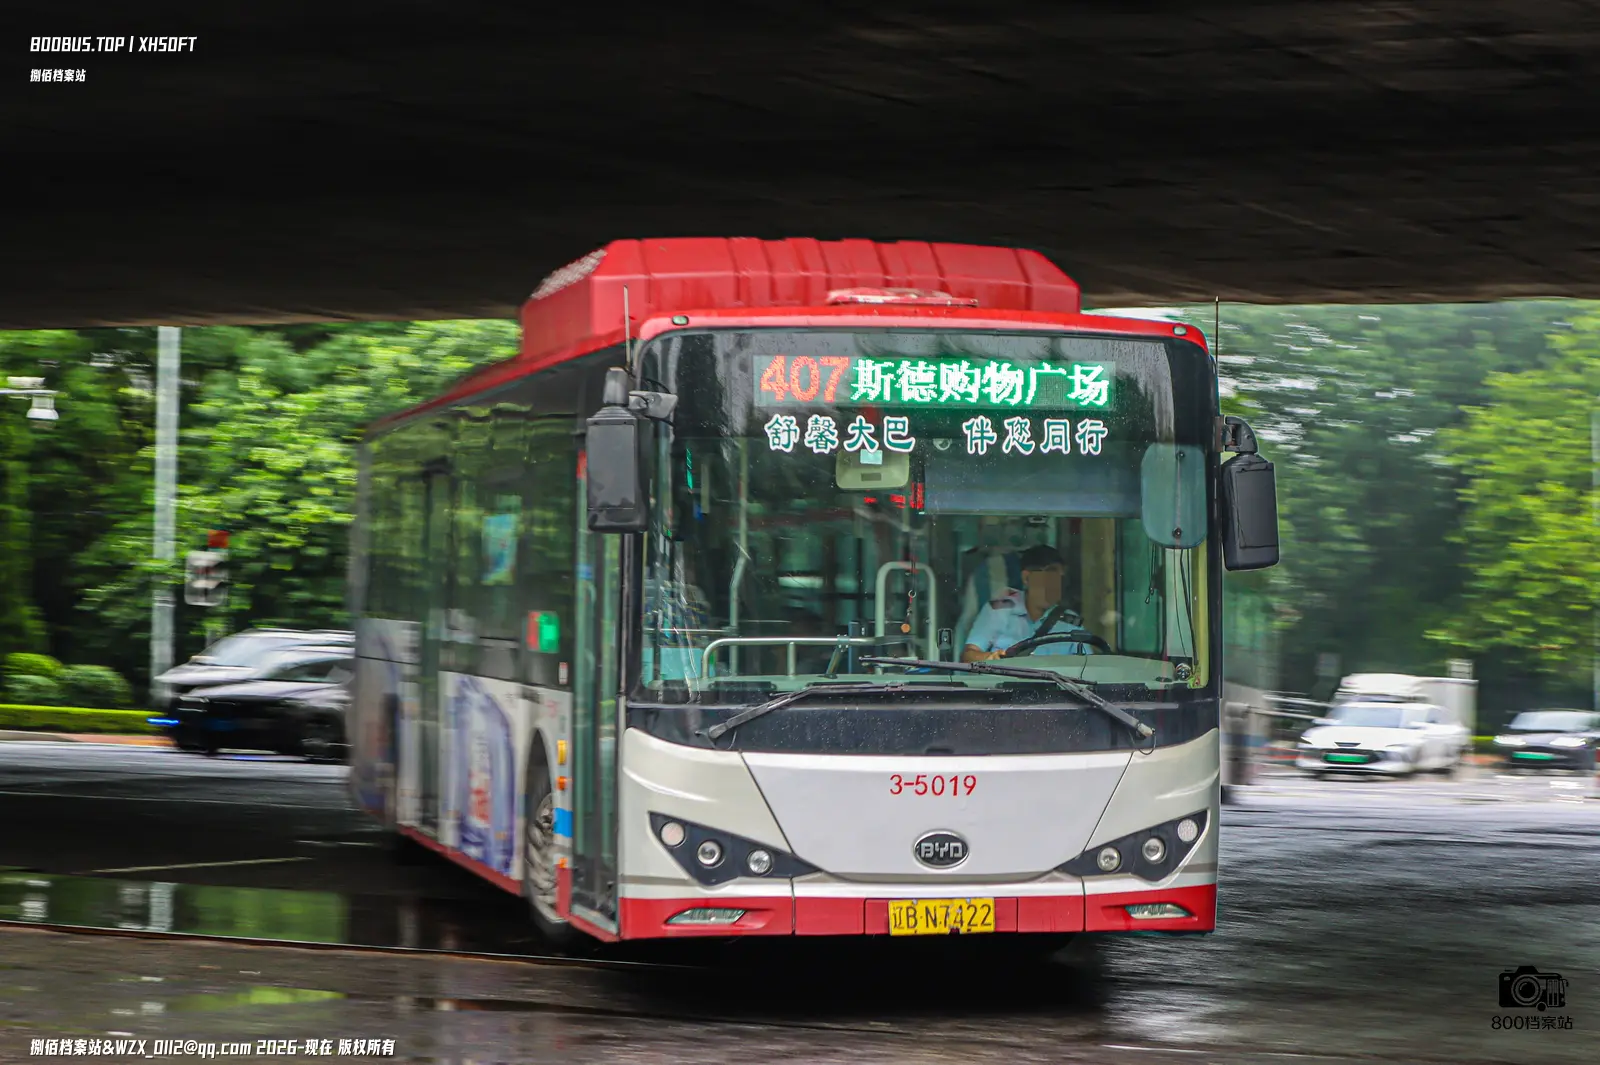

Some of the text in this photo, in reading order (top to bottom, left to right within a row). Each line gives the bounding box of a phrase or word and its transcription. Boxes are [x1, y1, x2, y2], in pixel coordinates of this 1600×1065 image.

[759, 355, 1110, 406] 407 斯德购物广场
[764, 414, 1109, 455] 舒馨大巴 伴您同行
[889, 774, 977, 797] 3-5019
[920, 842, 963, 858] BYD
